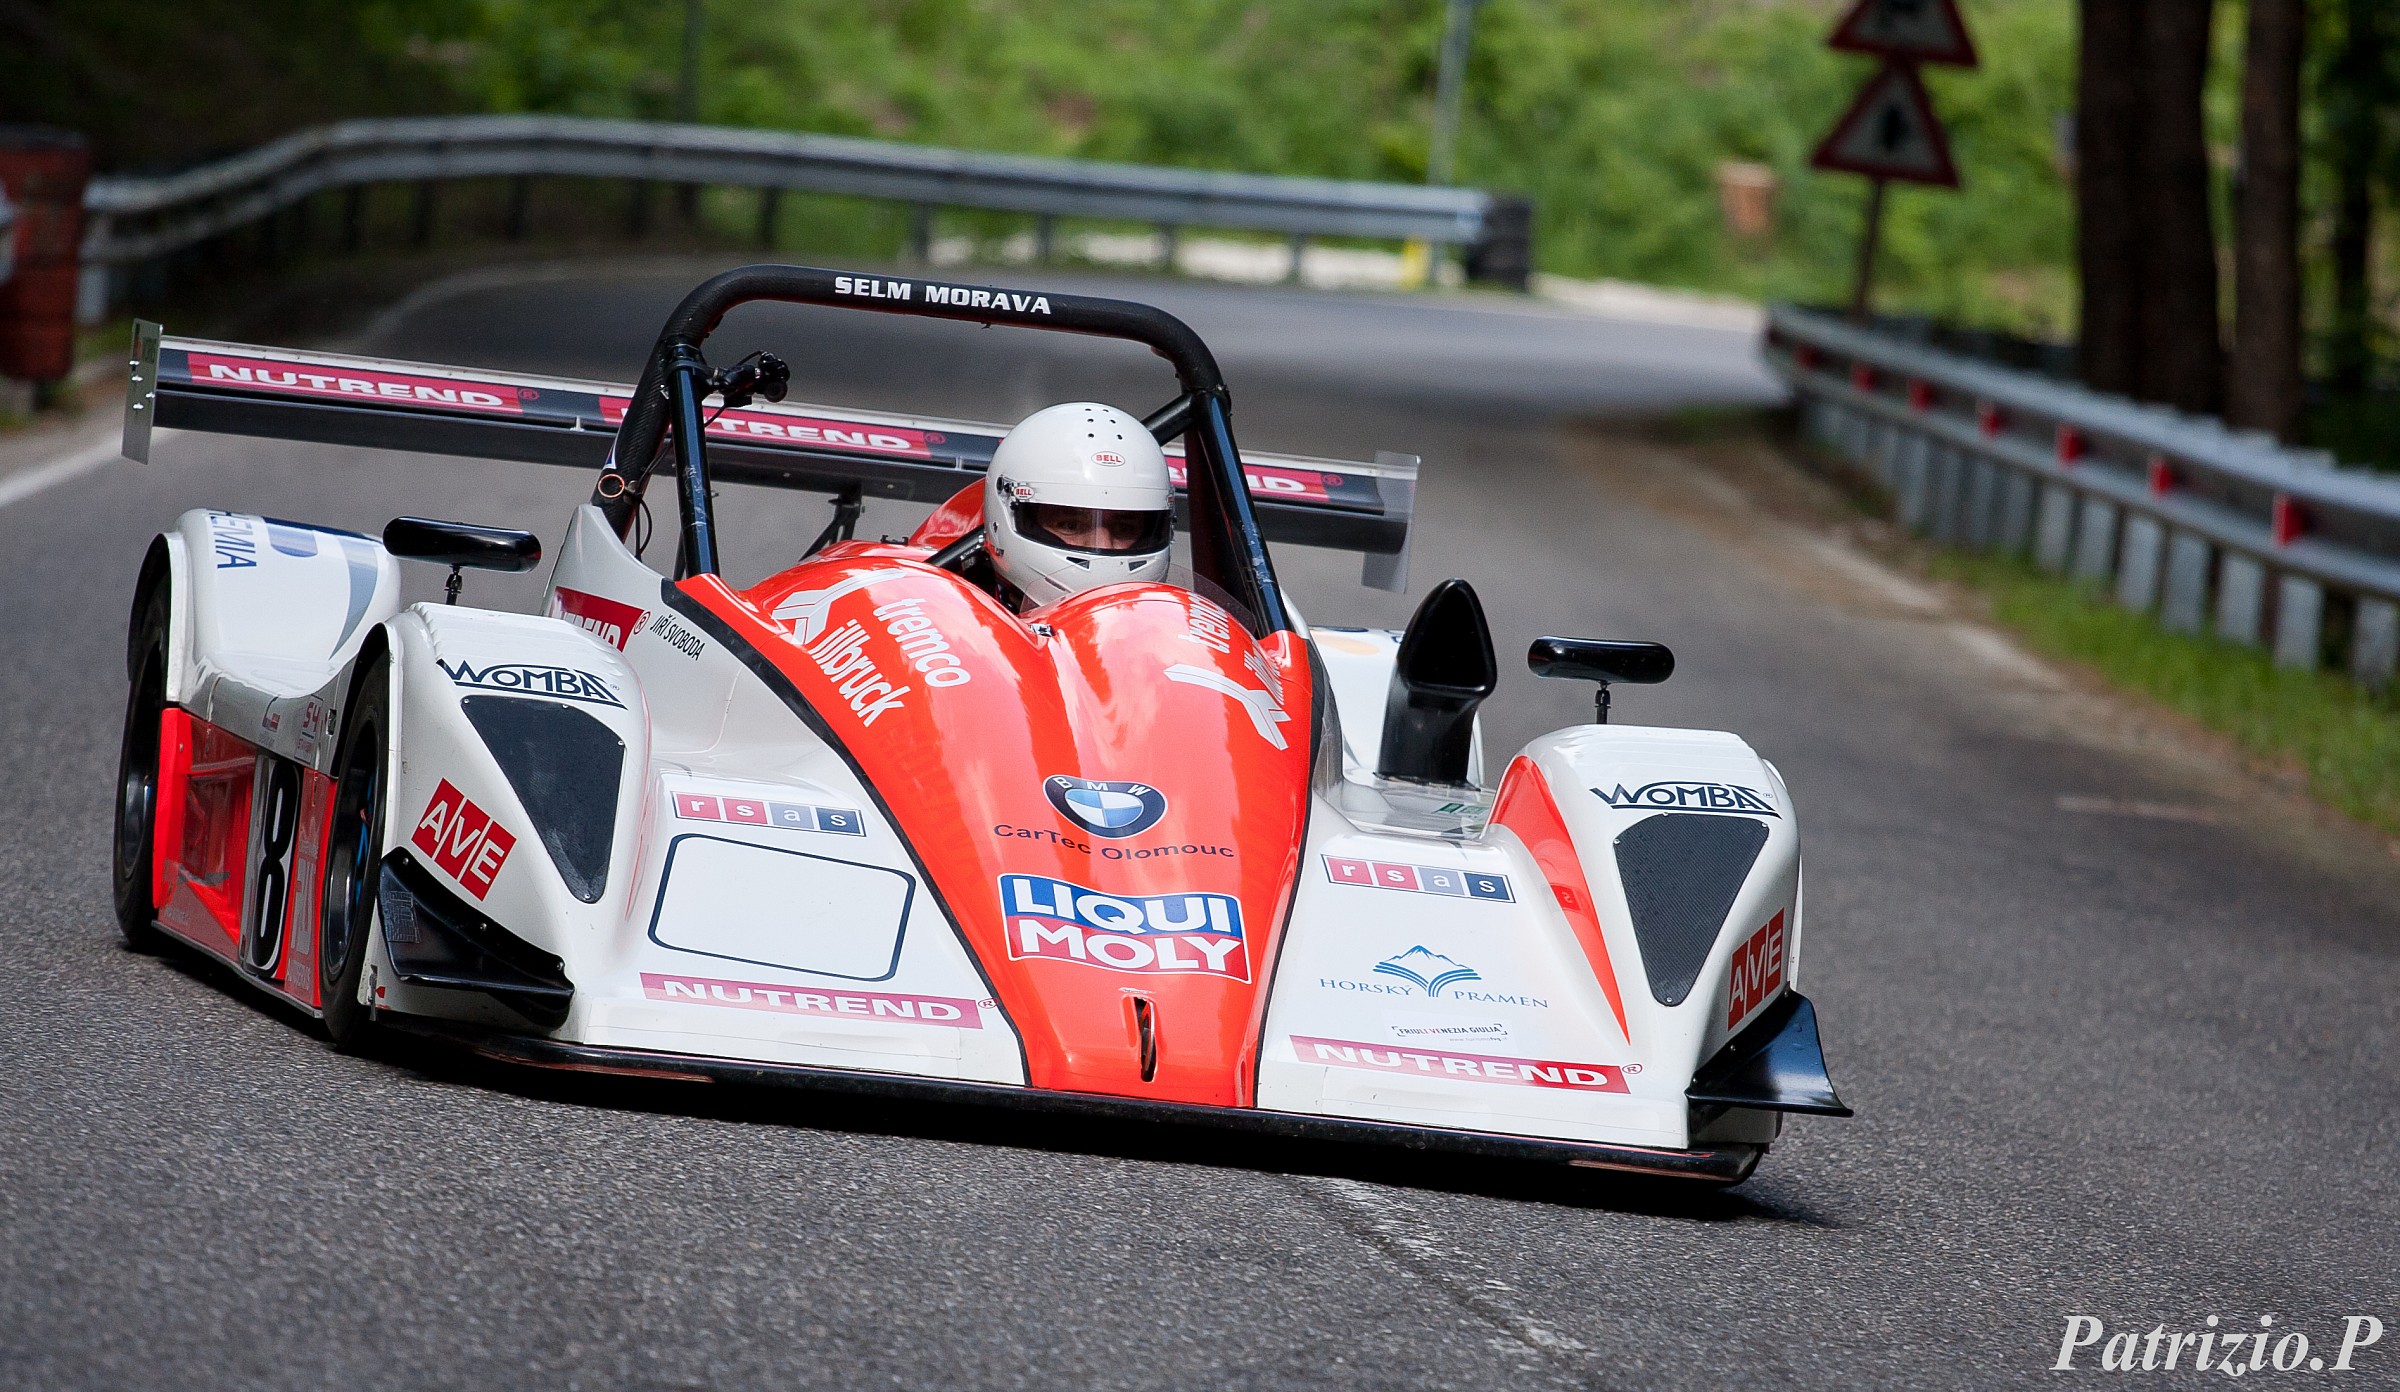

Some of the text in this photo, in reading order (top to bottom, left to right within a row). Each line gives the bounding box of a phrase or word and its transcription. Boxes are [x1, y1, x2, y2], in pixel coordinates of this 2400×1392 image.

[834, 275, 1052, 315] SELM MORAVA
[208, 363, 504, 407] NUTREND
[620, 406, 912, 450] TREND
[1095, 454, 1122, 463] BELL
[1015, 488, 1032, 496] BELL
[649, 613, 676, 637] JIŘÍ
[663, 623, 706, 662] SVOBODA
[872, 598, 972, 688] tremco
[807, 618, 912, 728] illbruck
[1053, 776, 1152, 797] BMW
[250, 753, 300, 971] 8
[418, 798, 506, 886] AVE
[993, 824, 1235, 860] CarTec Olomouc
[1012, 877, 1232, 935] LIQUI
[1018, 918, 1243, 972] MOLY
[1728, 926, 1784, 1014] AVE
[662, 979, 963, 1021] NUTREND
[1454, 989, 1549, 1009] PRAMEN
[1469, 1026, 1502, 1034] GIULIA
[1313, 1042, 1610, 1087] NUTREND
